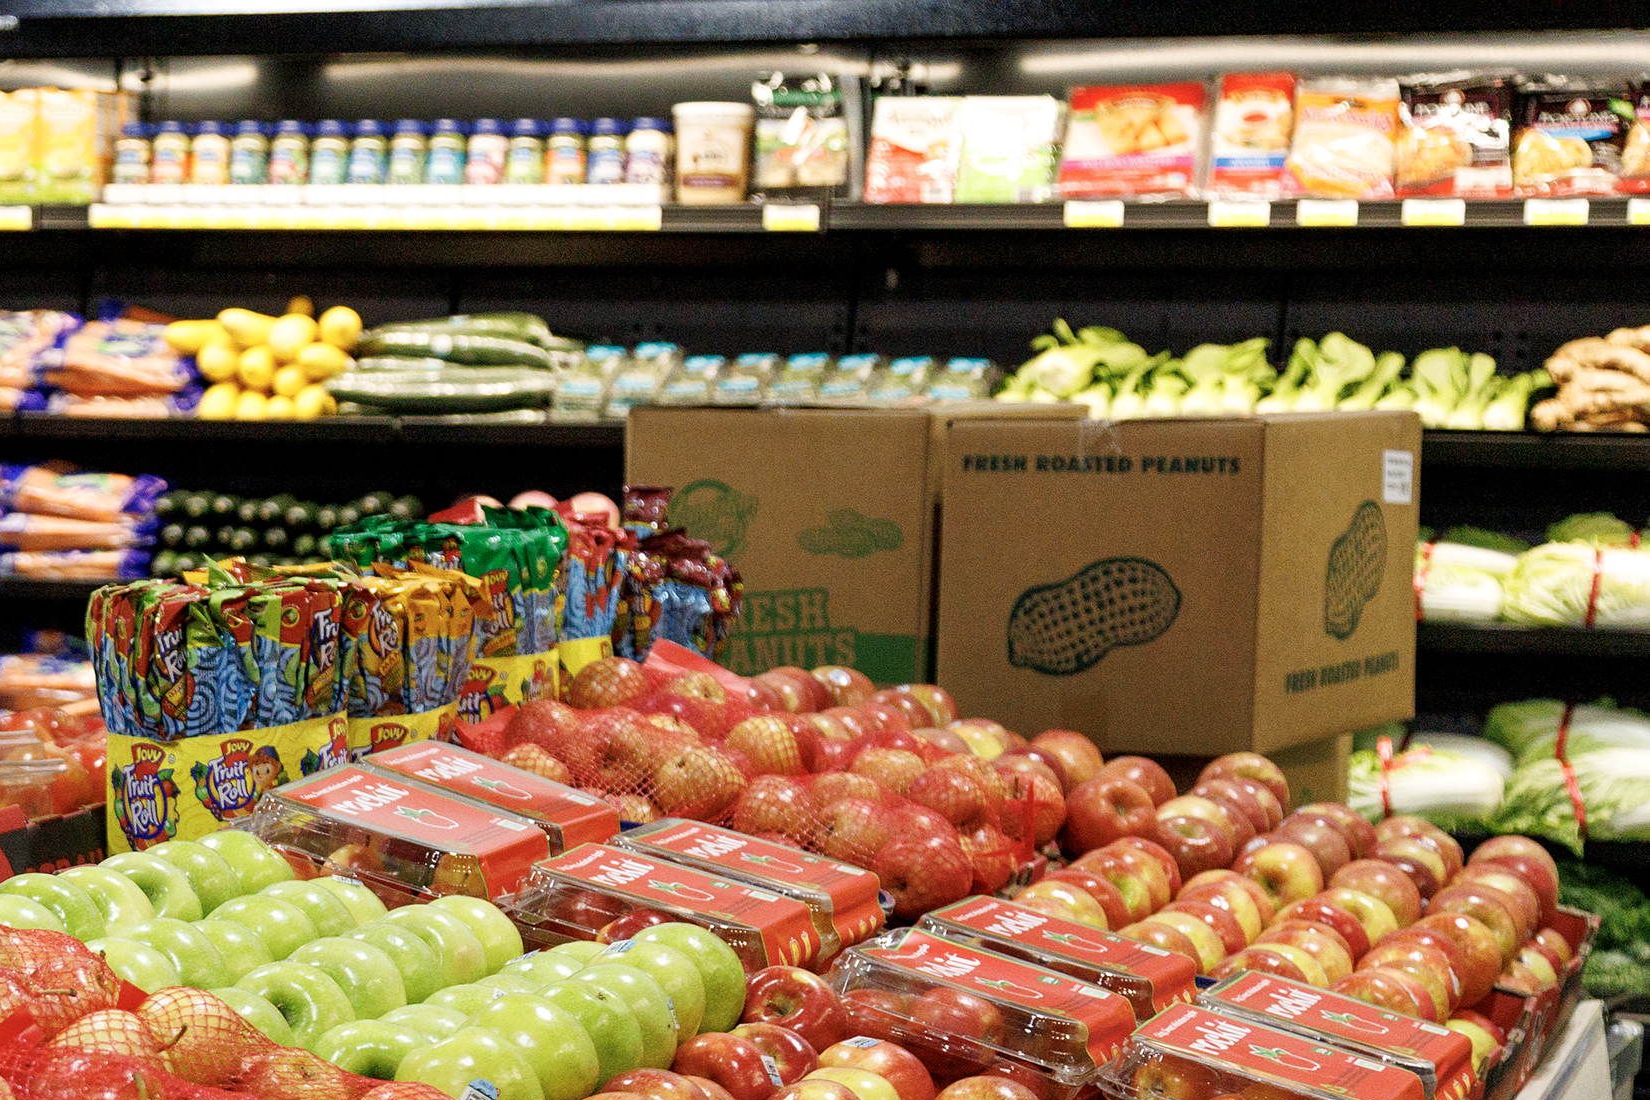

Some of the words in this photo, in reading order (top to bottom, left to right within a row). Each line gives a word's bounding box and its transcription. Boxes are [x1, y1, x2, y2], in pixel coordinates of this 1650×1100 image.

[962, 454, 1027, 473] FRESH
[1036, 454, 1133, 474] ROASTED
[1142, 455, 1241, 475] PEANUTS
[315, 608, 340, 642] Fru
[740, 594, 825, 631] ESH
[124, 762, 156, 800] Fruit
[211, 755, 247, 786] Fruit
[414, 756, 484, 781] rockit
[218, 777, 250, 807] Roll
[332, 783, 410, 815] rockit
[130, 797, 159, 834] Roll
[589, 858, 655, 887] rockit
[1265, 987, 1323, 1019] rockit
[1189, 1019, 1251, 1056] rockit
